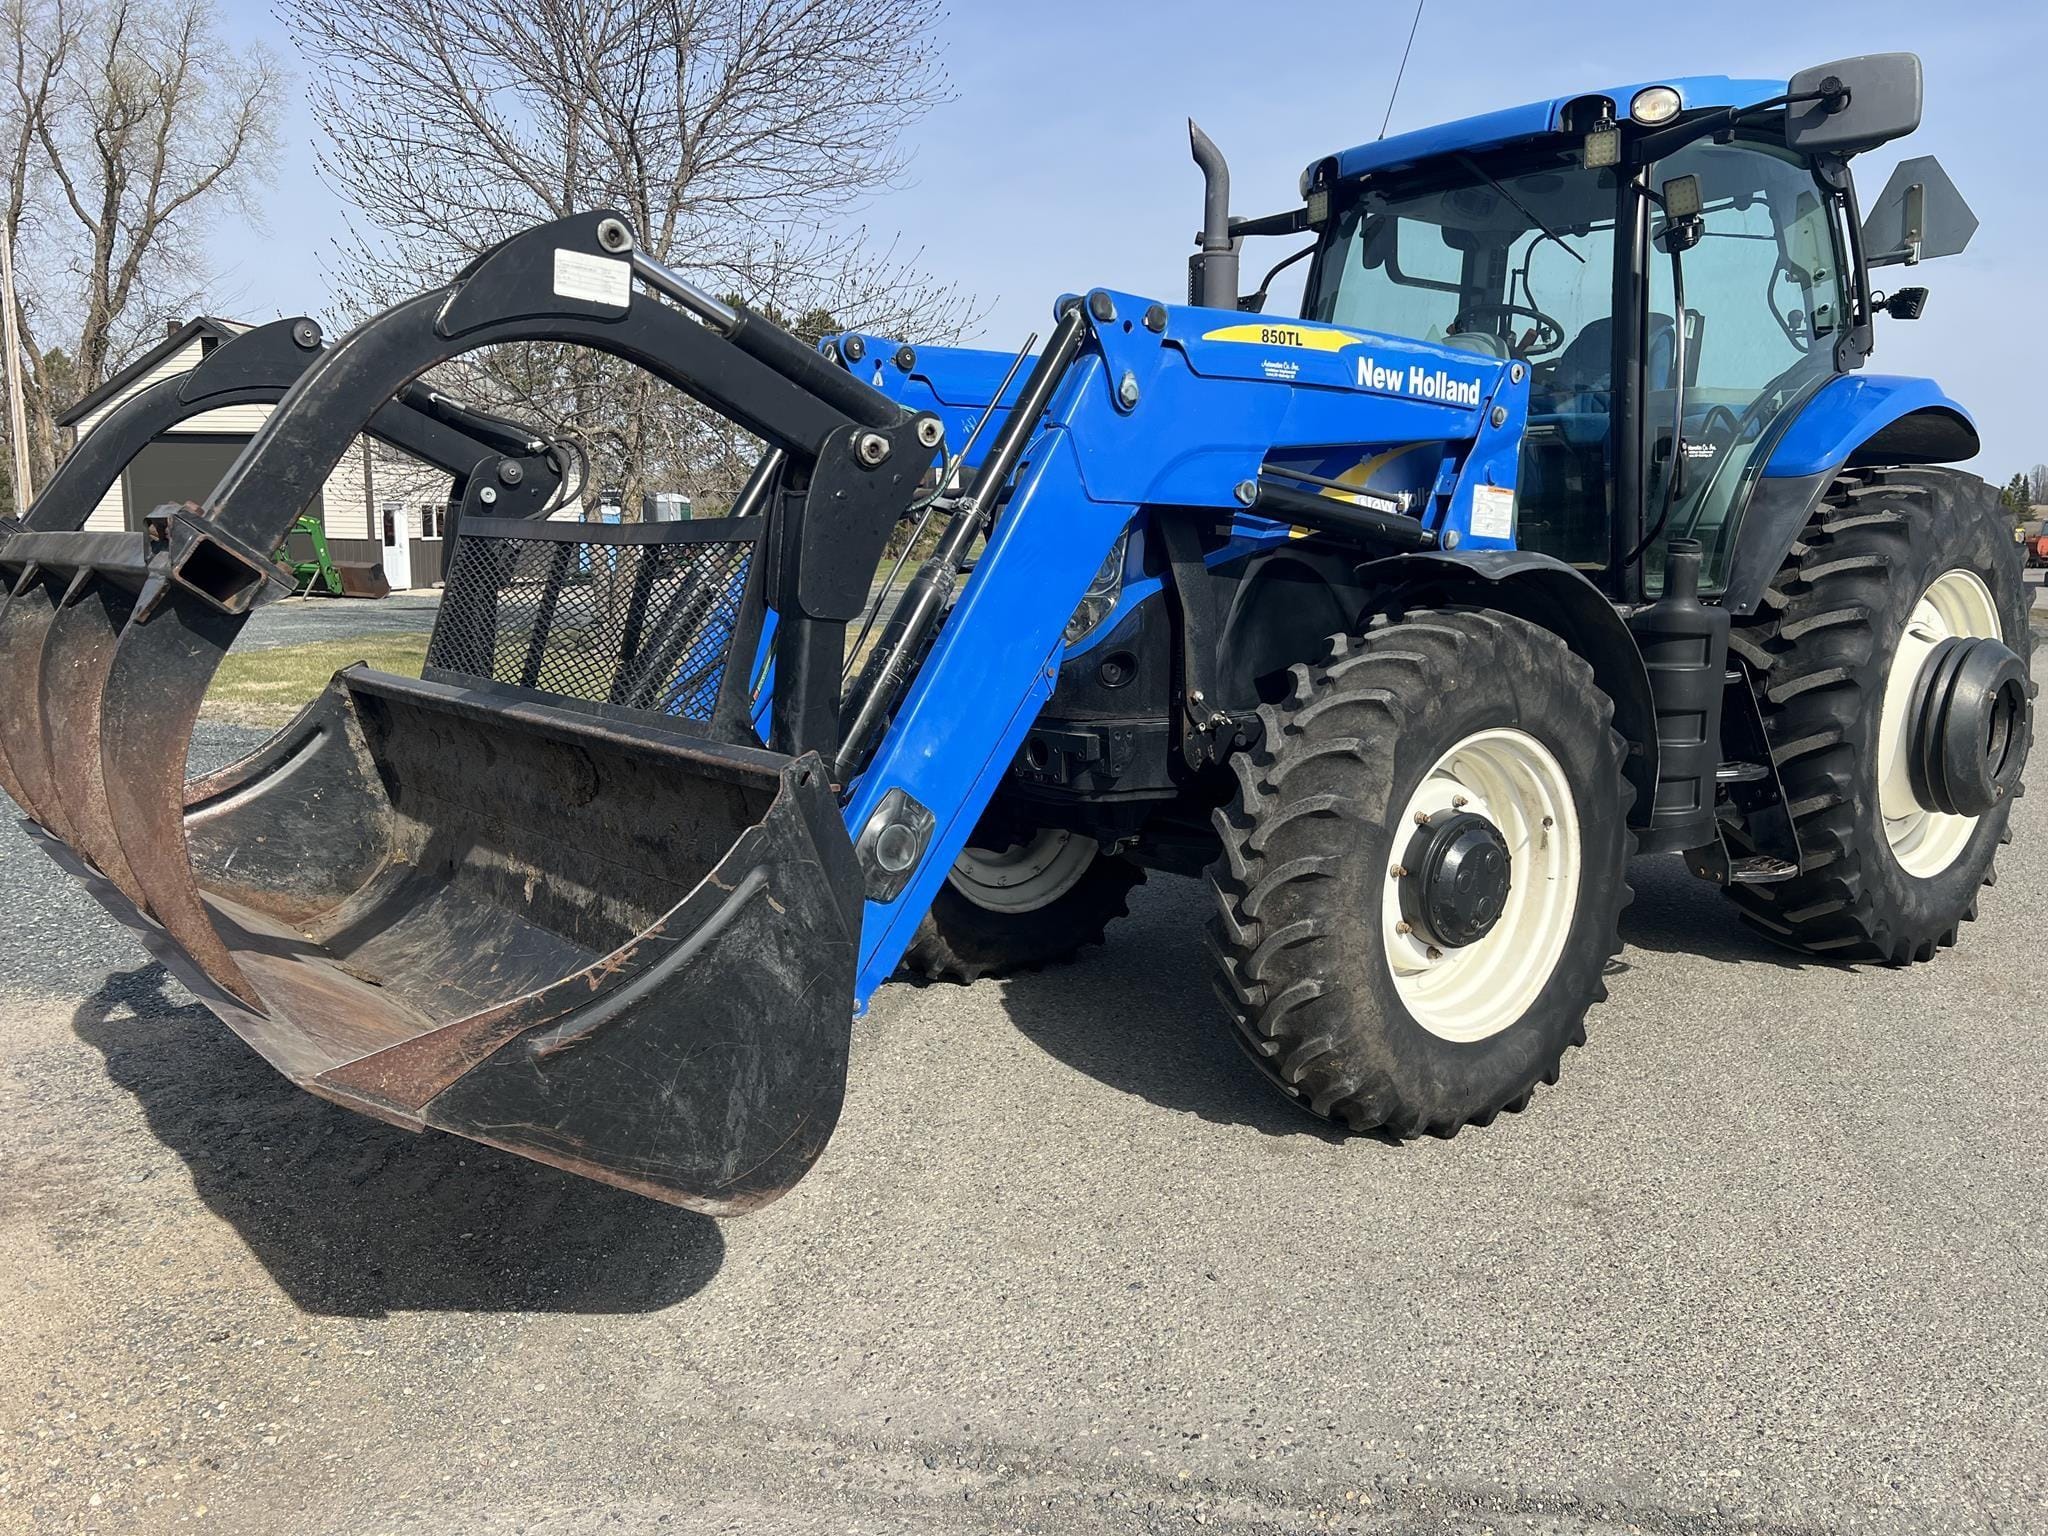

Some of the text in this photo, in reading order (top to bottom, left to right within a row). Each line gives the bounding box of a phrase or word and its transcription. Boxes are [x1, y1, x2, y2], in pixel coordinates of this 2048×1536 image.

[1262, 329, 1303, 346] 850TL
[1357, 356, 1480, 405] New Holland
